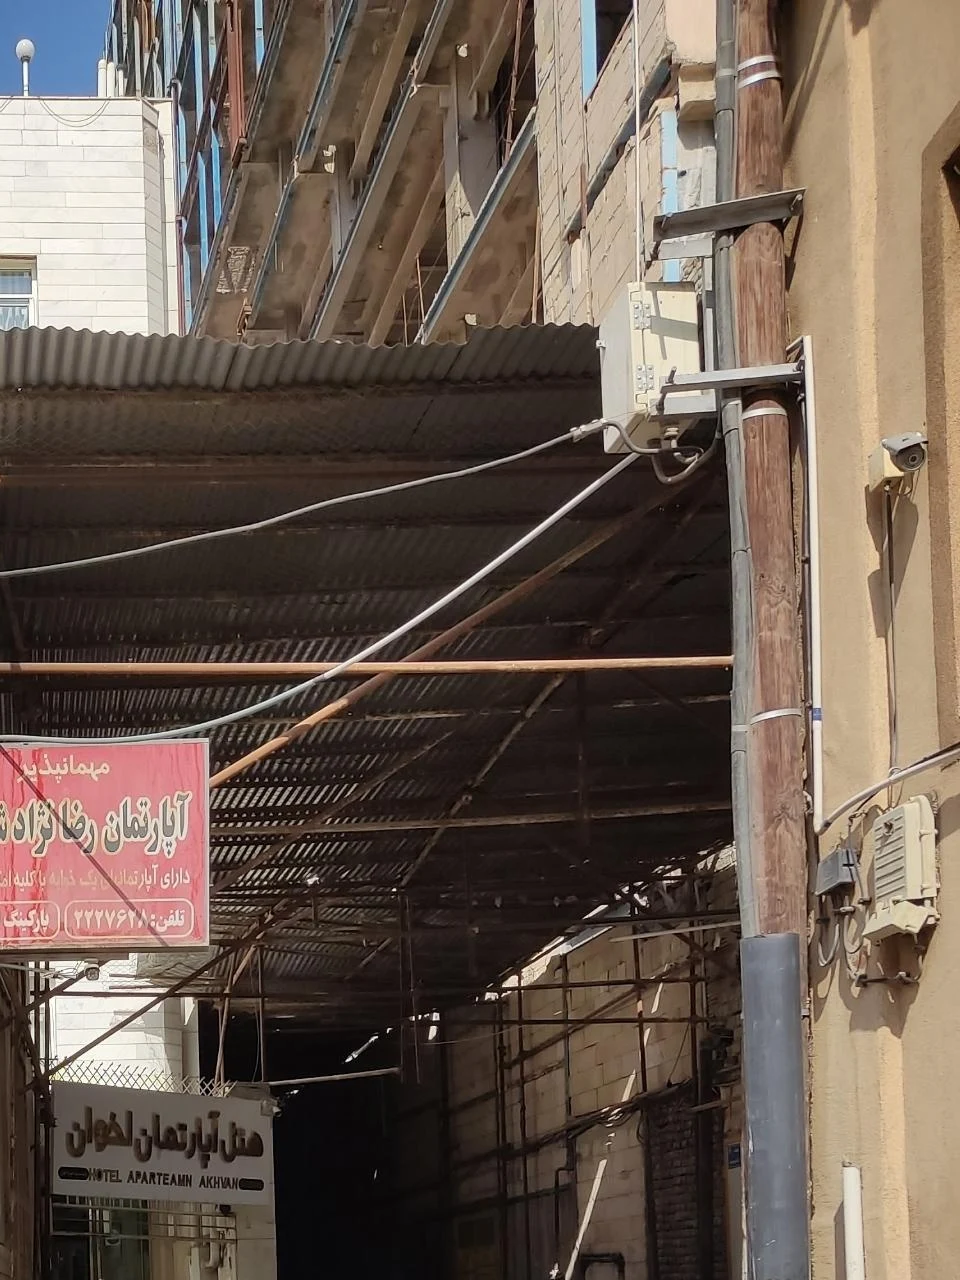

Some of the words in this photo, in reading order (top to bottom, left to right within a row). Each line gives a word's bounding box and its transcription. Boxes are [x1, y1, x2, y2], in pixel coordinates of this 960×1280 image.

[17, 753, 110, 783] مهمانپذیر
[12, 798, 56, 858] نژاد
[60, 797, 99, 855] رضا
[102, 790, 193, 859] آپارتمان
[159, 869, 190, 889] دارای
[3, 908, 50, 933] پارکینگ
[65, 1105, 133, 1158] اخوان
[134, 1110, 220, 1169] آپارتمان
[219, 1121, 264, 1162] هتل
[89, 1168, 122, 1183] HOTEL
[127, 1170, 193, 1188] APARTEAMN
[199, 1176, 238, 1191] AKHVAN
